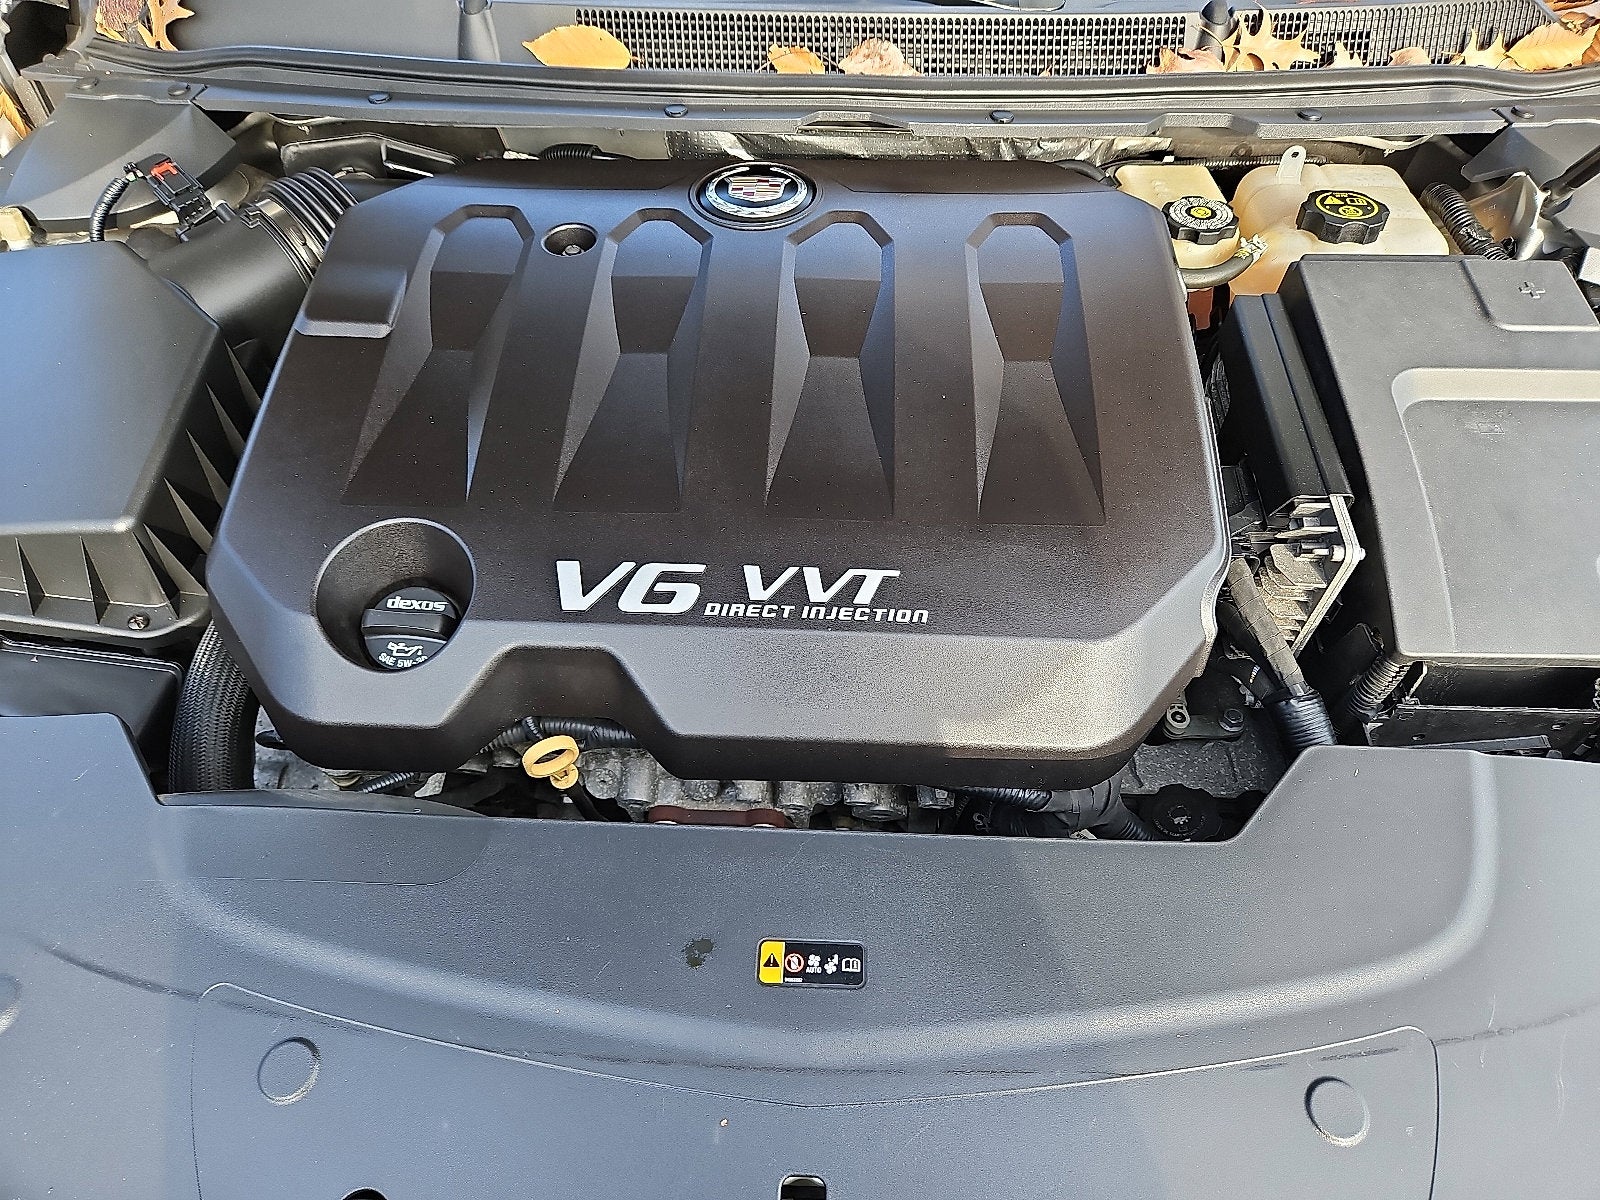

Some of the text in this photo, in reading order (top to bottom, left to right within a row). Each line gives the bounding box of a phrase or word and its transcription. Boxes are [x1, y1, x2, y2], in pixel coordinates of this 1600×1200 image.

[555, 560, 901, 614] V6 VVT
[386, 595, 449, 611] dexos
[703, 602, 929, 624] DIRECT INJECTION
[378, 652, 397, 666] SAE
[805, 966, 822, 974] AUTO
